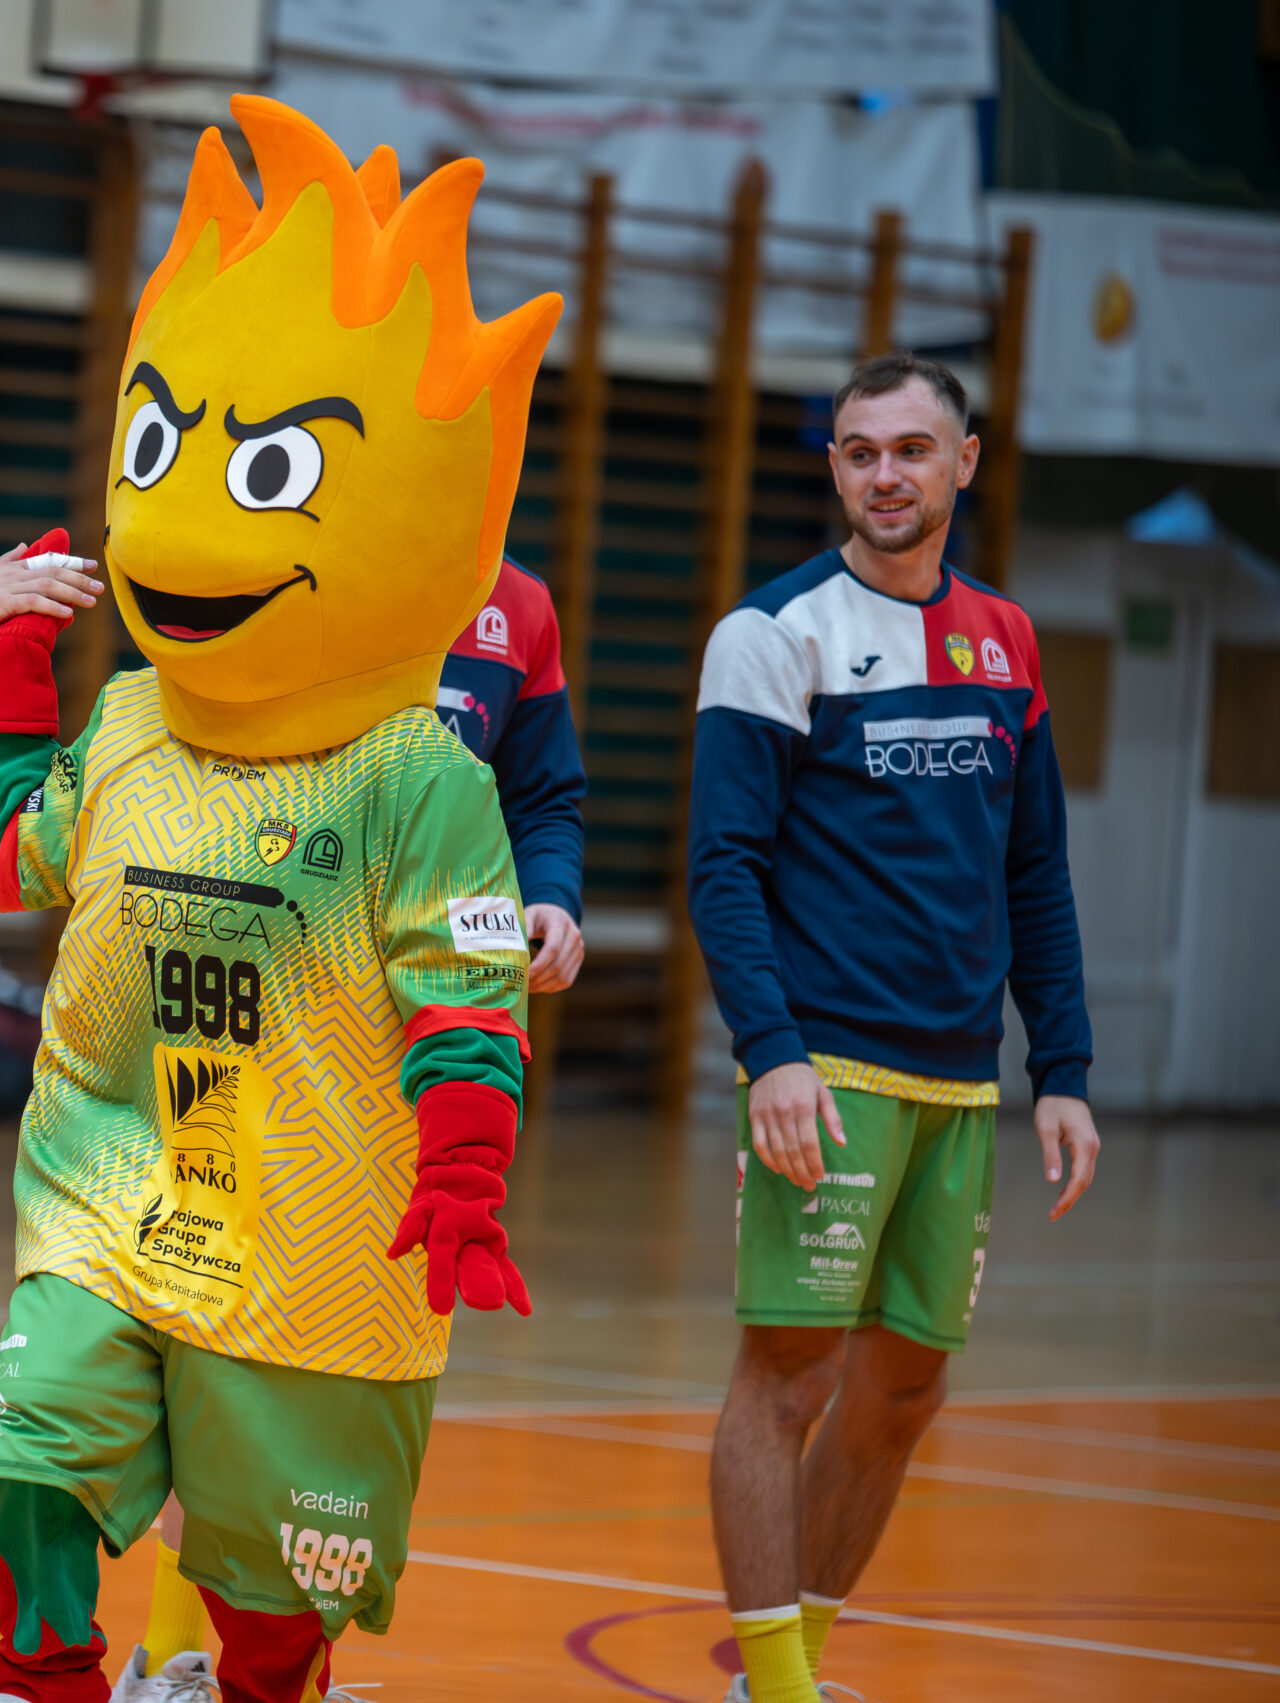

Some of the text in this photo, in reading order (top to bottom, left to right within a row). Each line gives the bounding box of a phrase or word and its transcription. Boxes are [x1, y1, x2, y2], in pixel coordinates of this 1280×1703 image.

[865, 740, 994, 778] BODEGA
[26, 786, 44, 812] WSKI
[268, 820, 290, 830] MKS
[127, 869, 241, 897] BUSINESS GROUP
[300, 868, 339, 882] GRUDZIĄDZ
[120, 892, 270, 949] BODEGA
[145, 944, 261, 1047] 1998
[170, 1163, 236, 1194] ANKO
[170, 1210, 224, 1231] rajowa
[820, 1196, 871, 1216] PASCAL
[158, 1223, 206, 1245] Grupa
[800, 1233, 860, 1250] SOLGRUD
[152, 1239, 241, 1272] Spożywcza
[132, 1266, 223, 1306] Grupa Kapitałowa
[290, 1488, 369, 1520] vadain
[280, 1522, 373, 1596] 1998
